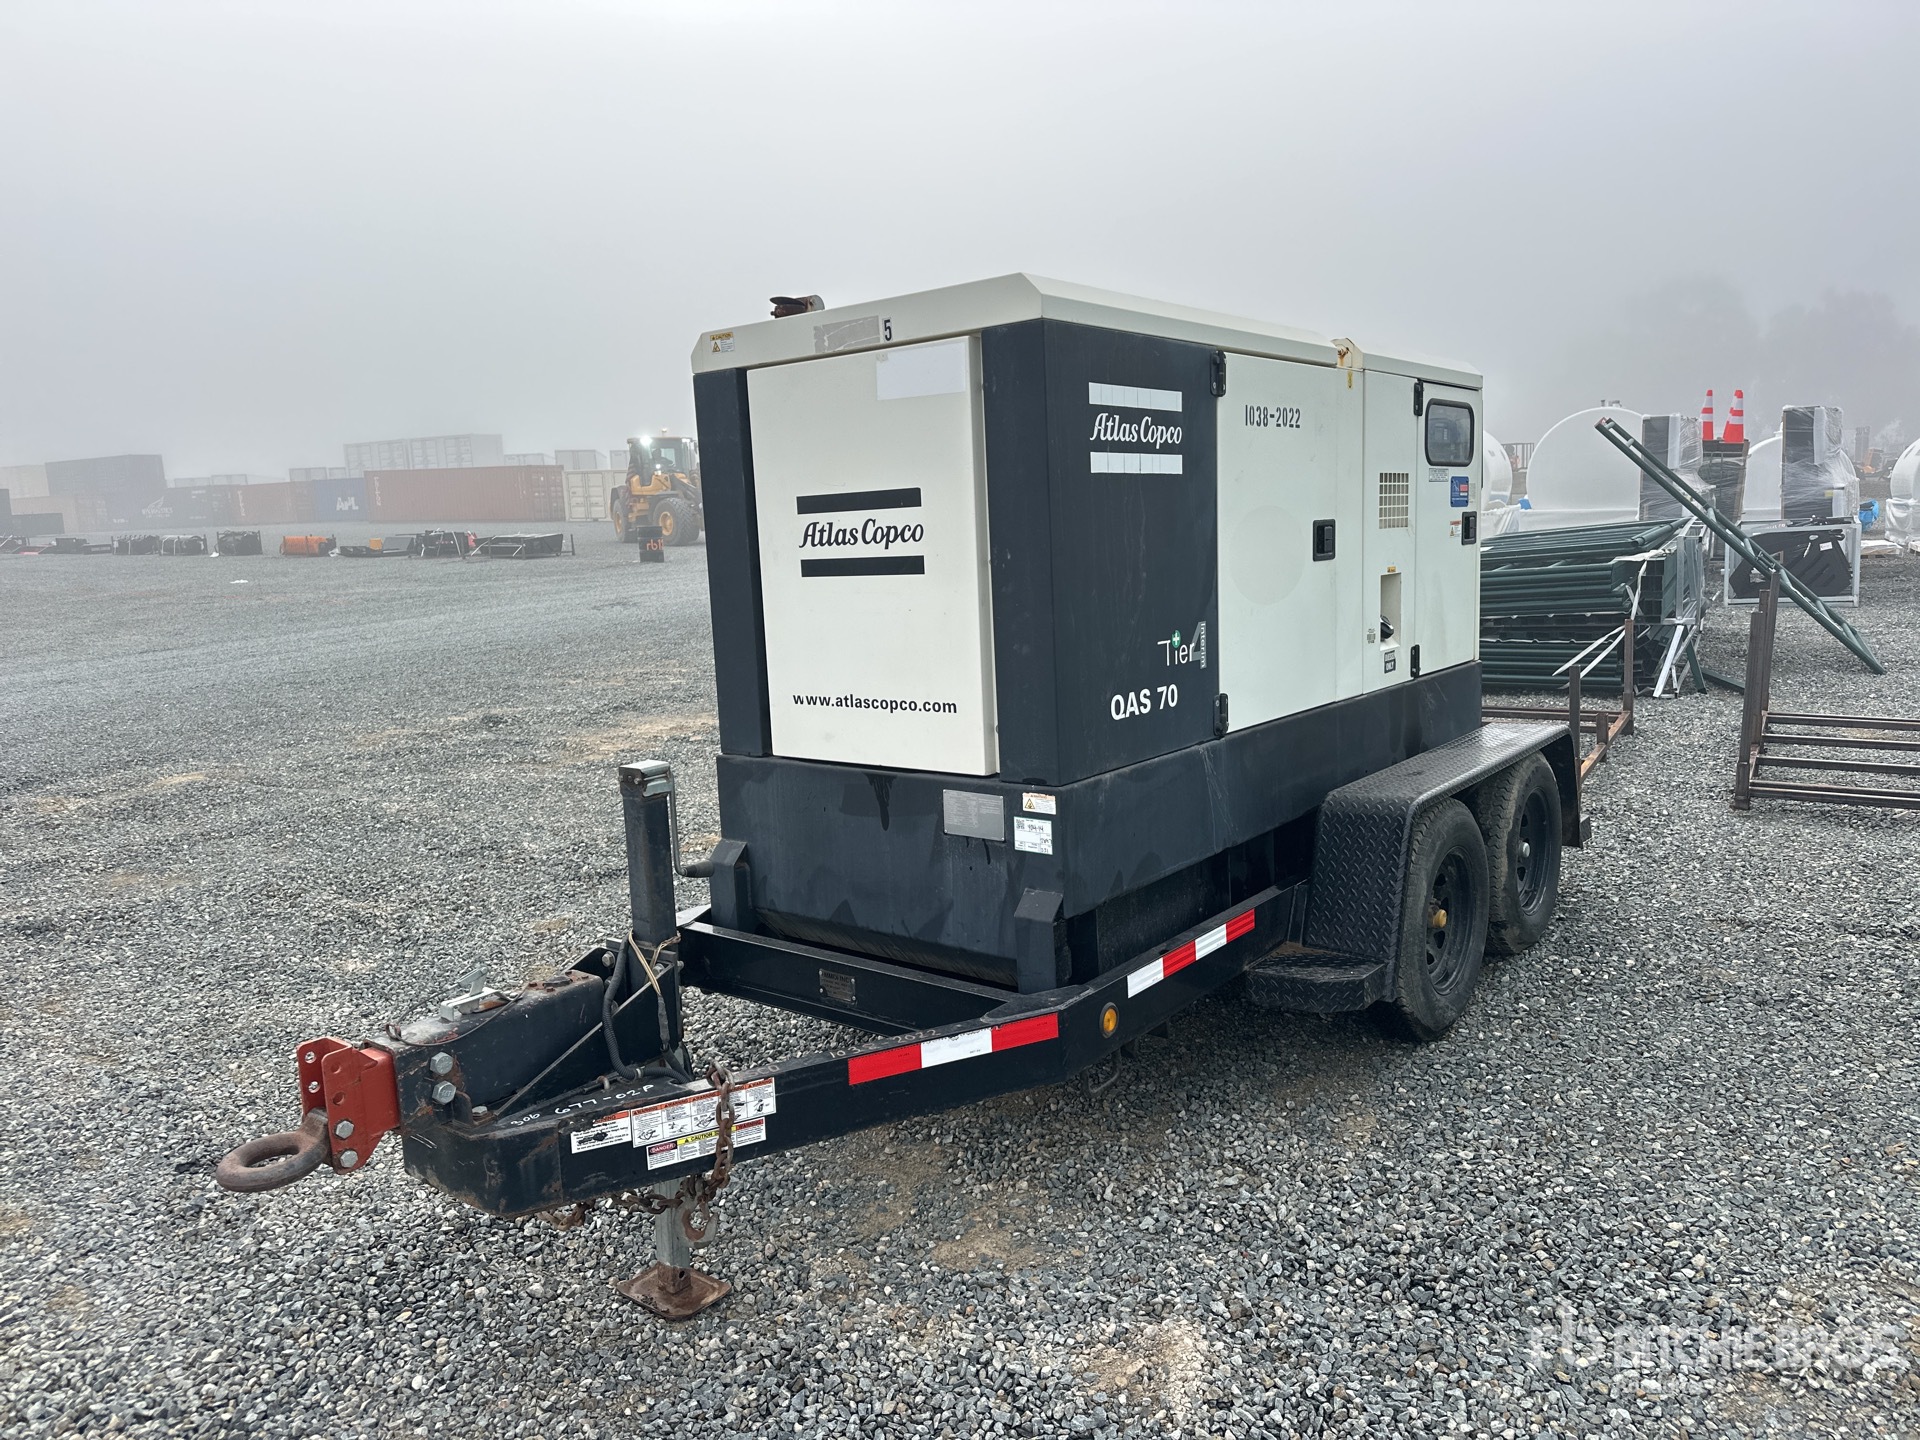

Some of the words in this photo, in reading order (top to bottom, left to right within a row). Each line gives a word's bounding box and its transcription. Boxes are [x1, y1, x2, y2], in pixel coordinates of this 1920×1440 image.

[884, 319, 892, 341] 5
[1245, 404, 1301, 428] 1038-2022
[1089, 412, 1138, 442] Atlas
[1140, 416, 1182, 449] Copco
[798, 521, 859, 548] Atlas
[861, 518, 924, 550] Copco
[1157, 632, 1194, 666] Tier
[793, 693, 957, 713] www.atlascopco.com
[1110, 688, 1152, 720] QAS
[1157, 683, 1179, 709] 70
[652, 1143, 674, 1152] DANGER
[690, 1132, 713, 1142] CAUTION
